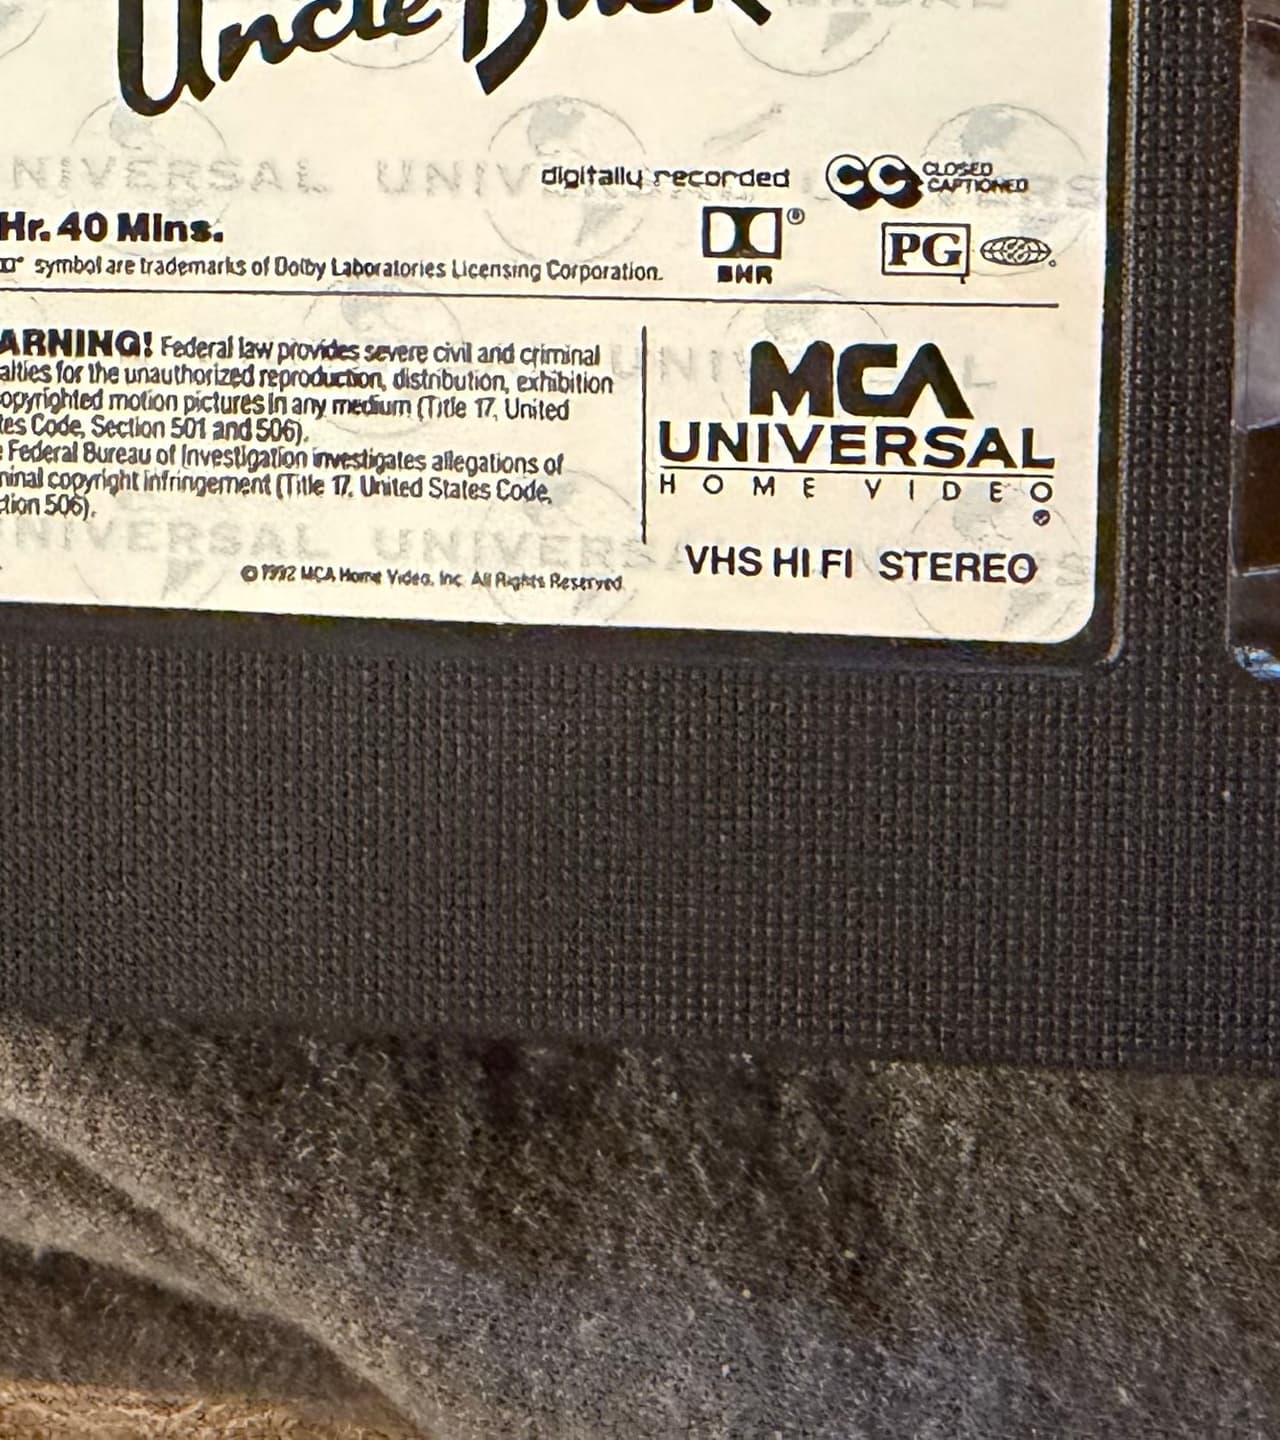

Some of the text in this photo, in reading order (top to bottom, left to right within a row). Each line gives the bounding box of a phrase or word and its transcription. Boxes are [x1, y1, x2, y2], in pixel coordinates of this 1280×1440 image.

[541, 166, 643, 190] digitally
[653, 168, 791, 188] recorded
[922, 161, 993, 177] CLOSED
[927, 178, 1030, 194] CAPTIONED
[0, 211, 51, 242] Hr.
[57, 212, 108, 242] 40
[118, 212, 224, 244] Mins.
[888, 232, 964, 267] PG
[34, 256, 102, 278] symbol
[105, 258, 135, 275] are
[140, 256, 247, 277] trademarks
[251, 256, 271, 277] of
[274, 256, 327, 281] Dolby
[331, 256, 447, 280] Laboratories
[452, 258, 542, 283] Licensing
[546, 259, 664, 284] Corporation.
[161, 335, 234, 358] Federal
[238, 335, 274, 359] law
[276, 338, 361, 365] provides
[363, 344, 429, 362] severe
[433, 341, 472, 363] civil
[477, 342, 516, 364] and
[519, 344, 601, 369] criminal
[55, 361, 83, 385] for
[88, 362, 120, 385] the
[124, 363, 256, 389] unauthorized
[259, 366, 387, 392] reproduction,
[392, 368, 510, 394] distribution,
[516, 371, 615, 394] exhibition
[749, 339, 975, 420] MCA
[108, 389, 179, 412] motion
[183, 391, 265, 416] pictures
[269, 393, 287, 415] in
[291, 397, 327, 420] any
[331, 395, 412, 417] medium
[417, 396, 468, 422] (Title
[504, 398, 570, 421] United
[31, 413, 86, 439] Code,
[90, 415, 165, 439] Section
[170, 417, 207, 440] 501
[211, 418, 253, 441] and
[8, 439, 78, 463] Federal
[83, 441, 152, 464] Bureau
[156, 443, 176, 466] of
[182, 443, 308, 474] Investigation
[312, 447, 426, 475] investigates
[431, 449, 539, 477] allegations
[543, 452, 565, 475] of
[658, 420, 1056, 470] UNIVERSAL
[47, 467, 139, 496] copyright
[143, 469, 271, 497] infringement
[276, 472, 325, 500] (Title
[359, 475, 423, 498] United
[428, 476, 491, 501] States
[659, 473, 1055, 503] HOME VIDEO
[44, 494, 98, 521] 506).
[339, 567, 382, 585] Home
[471, 571, 492, 587] All
[495, 571, 546, 591] Rights
[684, 544, 1039, 584] VHS HI FI STEREO
